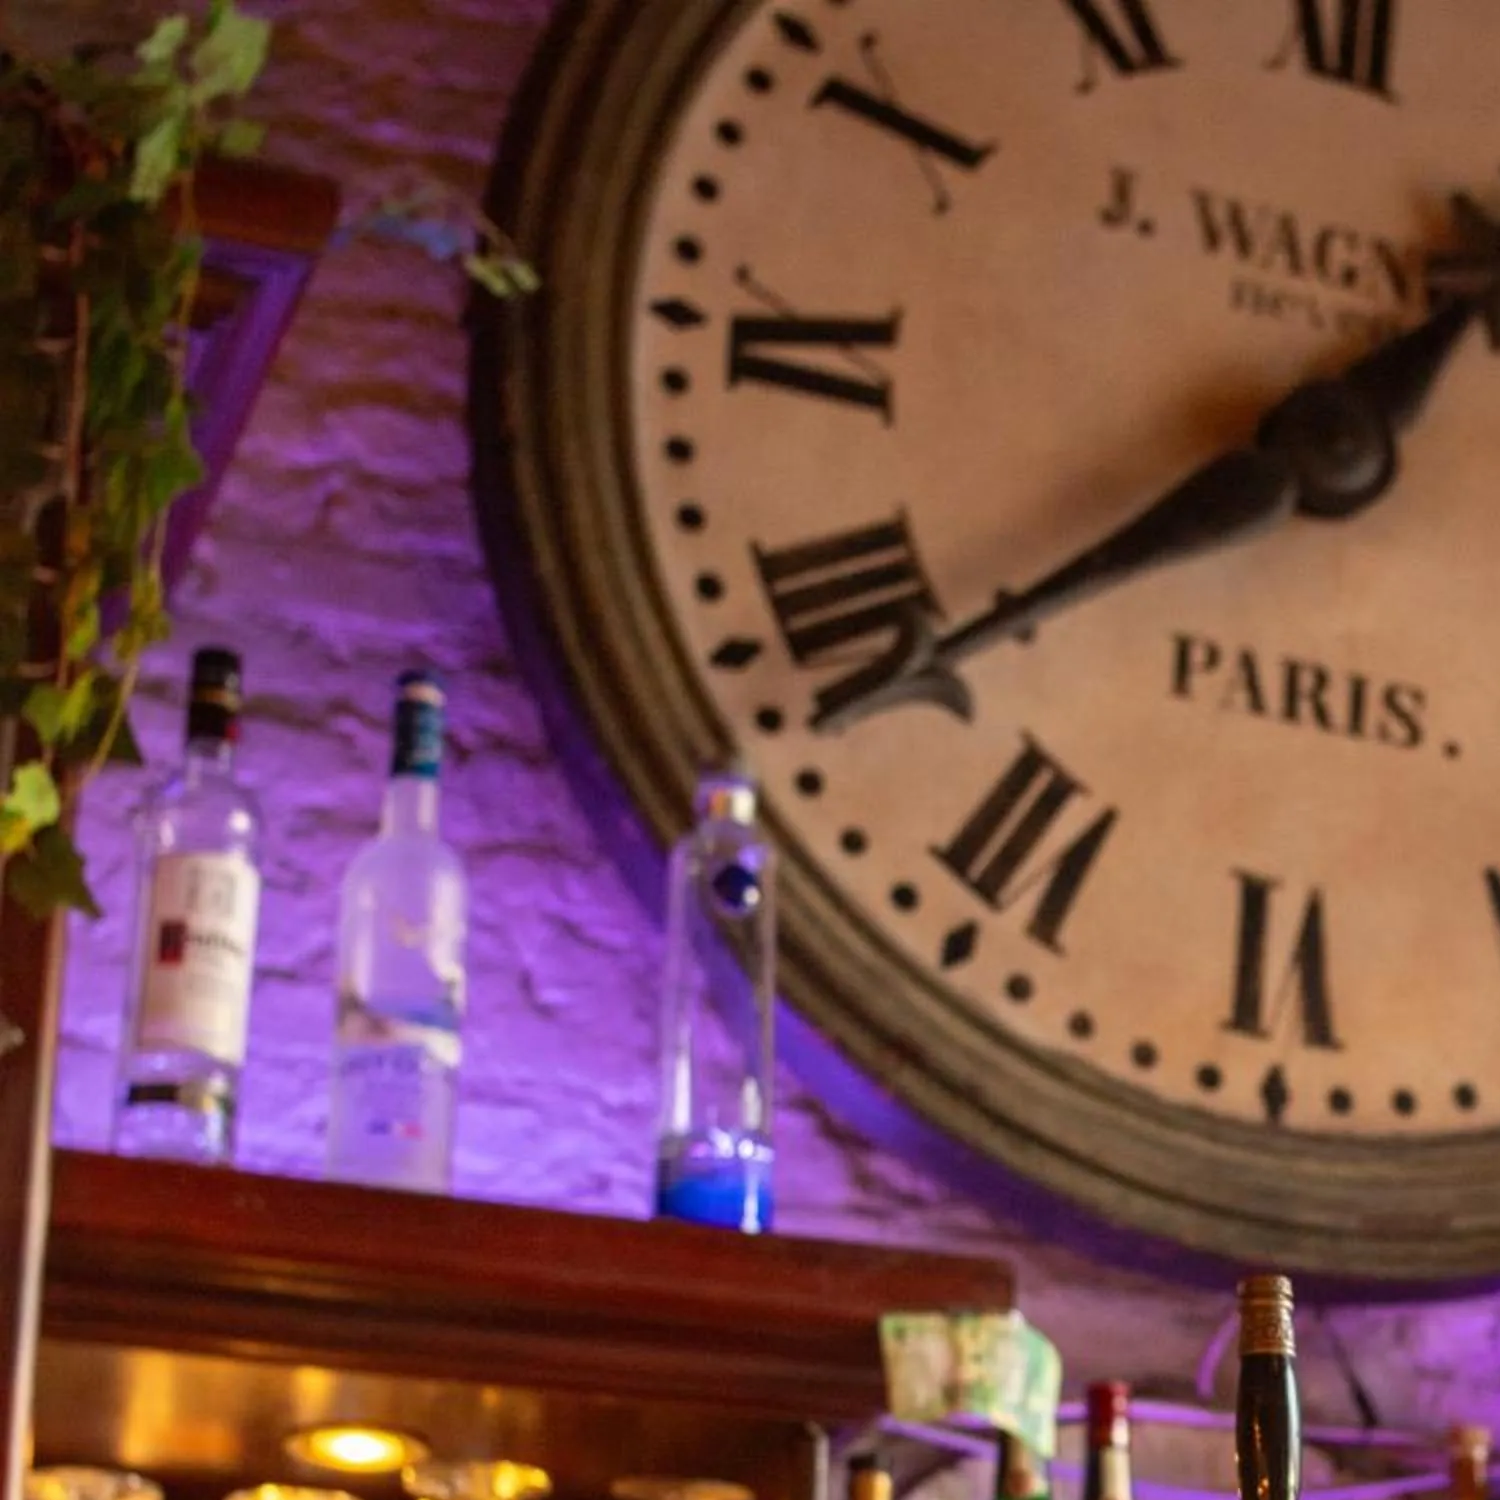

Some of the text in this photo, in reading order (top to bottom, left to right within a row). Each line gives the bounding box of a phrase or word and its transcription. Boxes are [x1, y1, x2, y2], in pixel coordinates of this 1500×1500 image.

[1097, 164, 1157, 238] J.
[1192, 184, 1420, 306] WAGN
[928, 730, 1119, 958] VII
[1221, 867, 1344, 1052] VI
